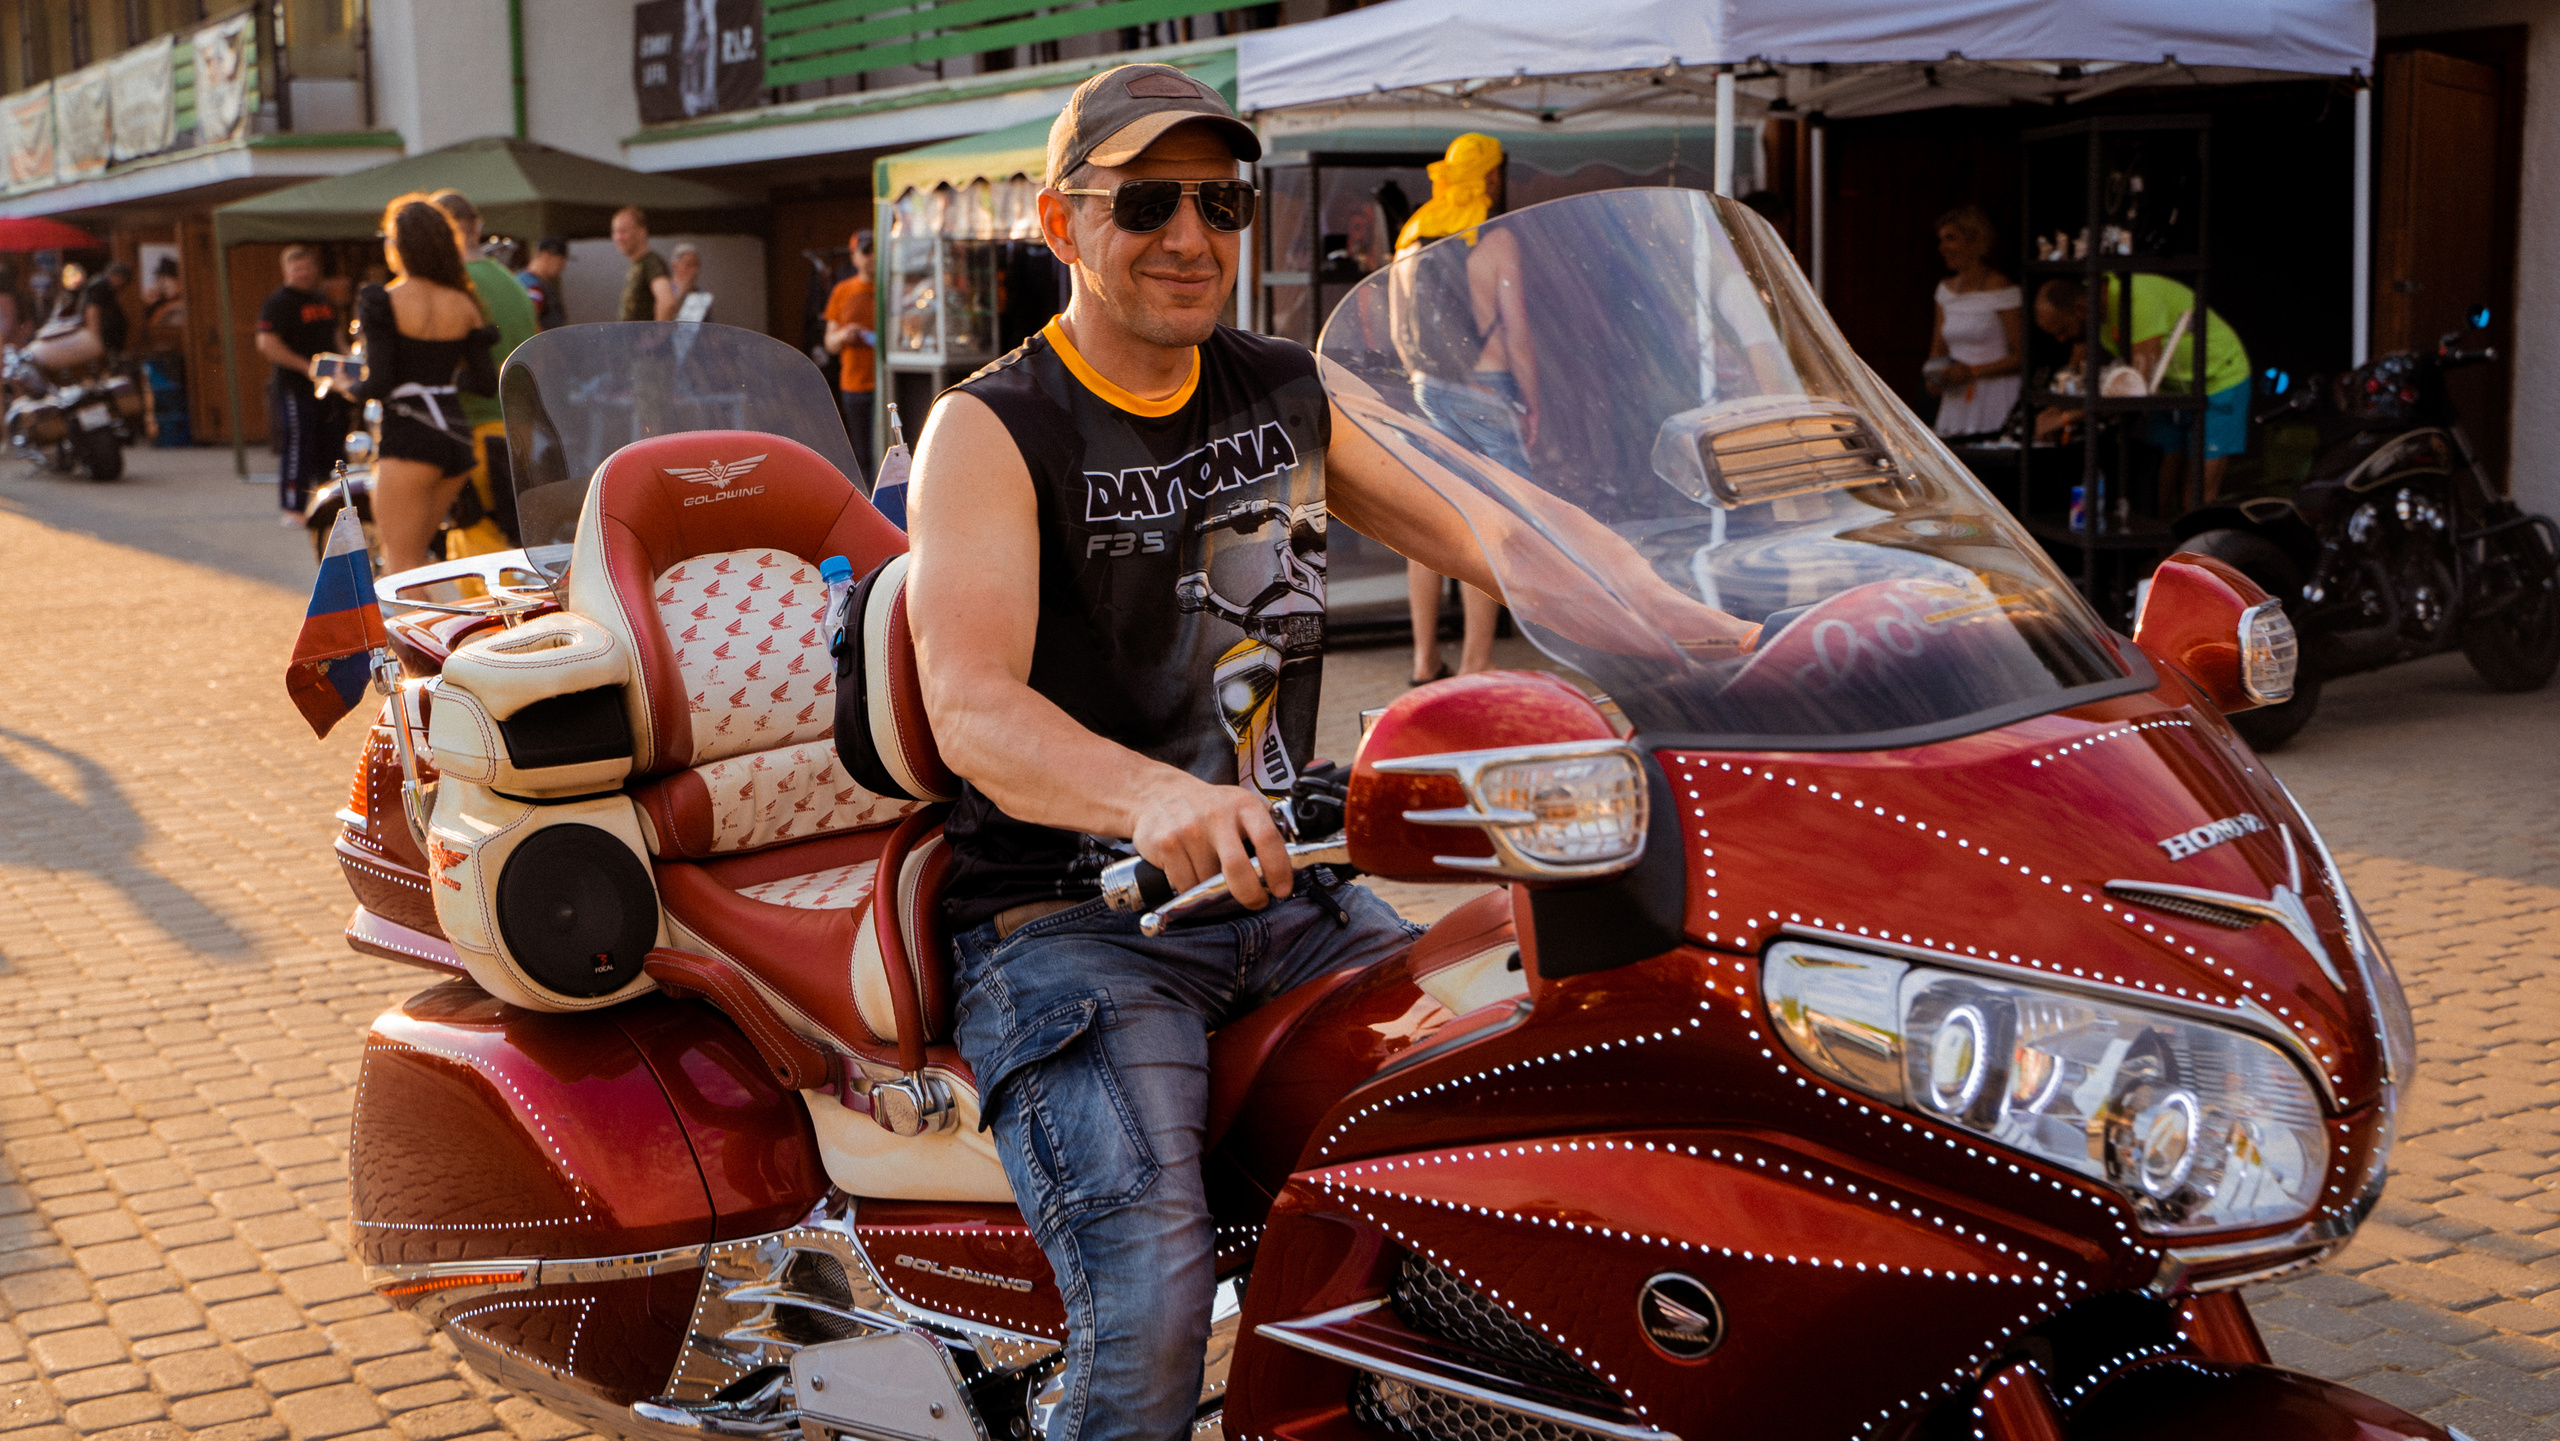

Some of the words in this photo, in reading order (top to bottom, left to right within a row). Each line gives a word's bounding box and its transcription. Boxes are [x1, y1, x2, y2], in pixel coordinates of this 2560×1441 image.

[1083, 421, 1299, 522] DAYTONA
[683, 485, 766, 507] GOLDWING
[671, 576, 694, 584] HONDA
[684, 636, 706, 644] HONDA
[789, 668, 810, 676] HONDA
[814, 689, 836, 697] HONDA
[796, 718, 818, 726] HONDA
[2157, 812, 2266, 861] HONDA
[594, 964, 614, 974] FOCAL
[894, 1253, 1034, 1293] GOLDWING
[1650, 1325, 1710, 1343] HONDA
